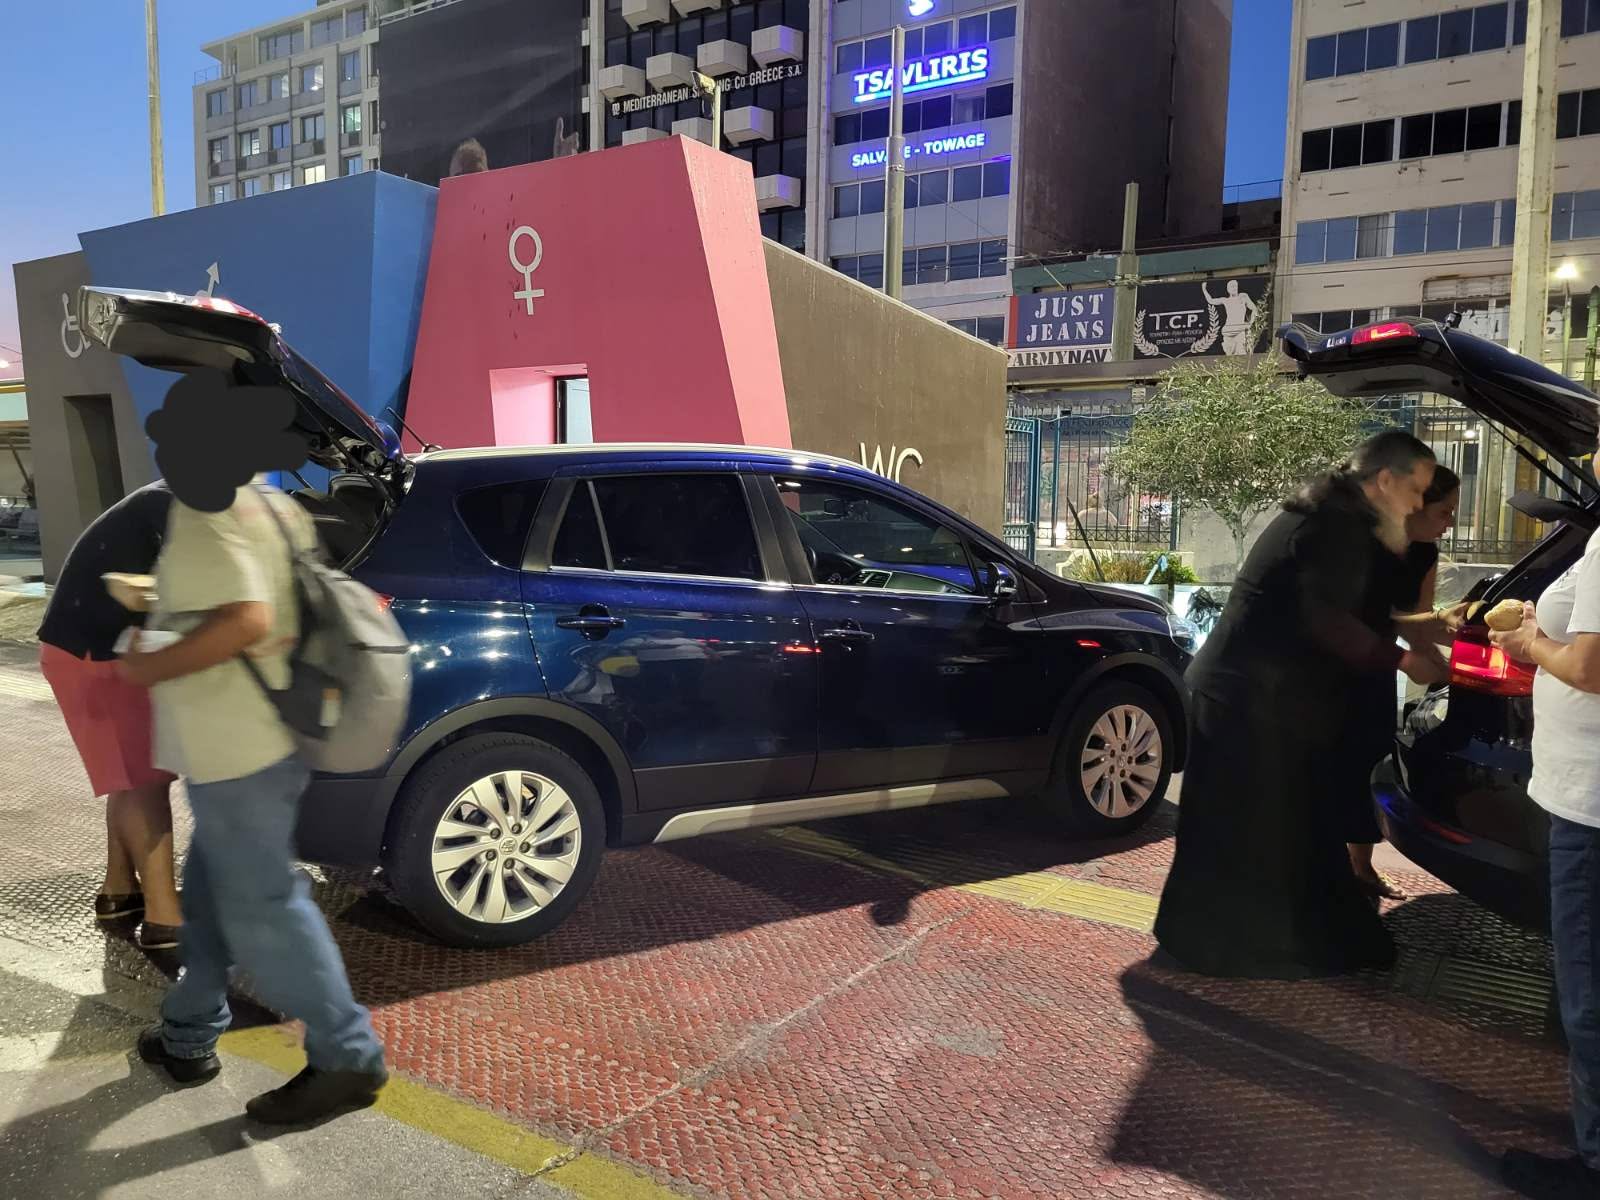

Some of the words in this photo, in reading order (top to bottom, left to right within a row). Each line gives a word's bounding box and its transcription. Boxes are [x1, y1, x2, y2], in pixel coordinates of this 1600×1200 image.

[623, 87, 688, 113] MEDITERRANEAN
[750, 66, 784, 86] GREECE
[852, 146, 911, 167] SALVE
[924, 133, 985, 154] TOWAGE
[1034, 294, 1104, 319] JUST
[1026, 320, 1104, 342] JEANS
